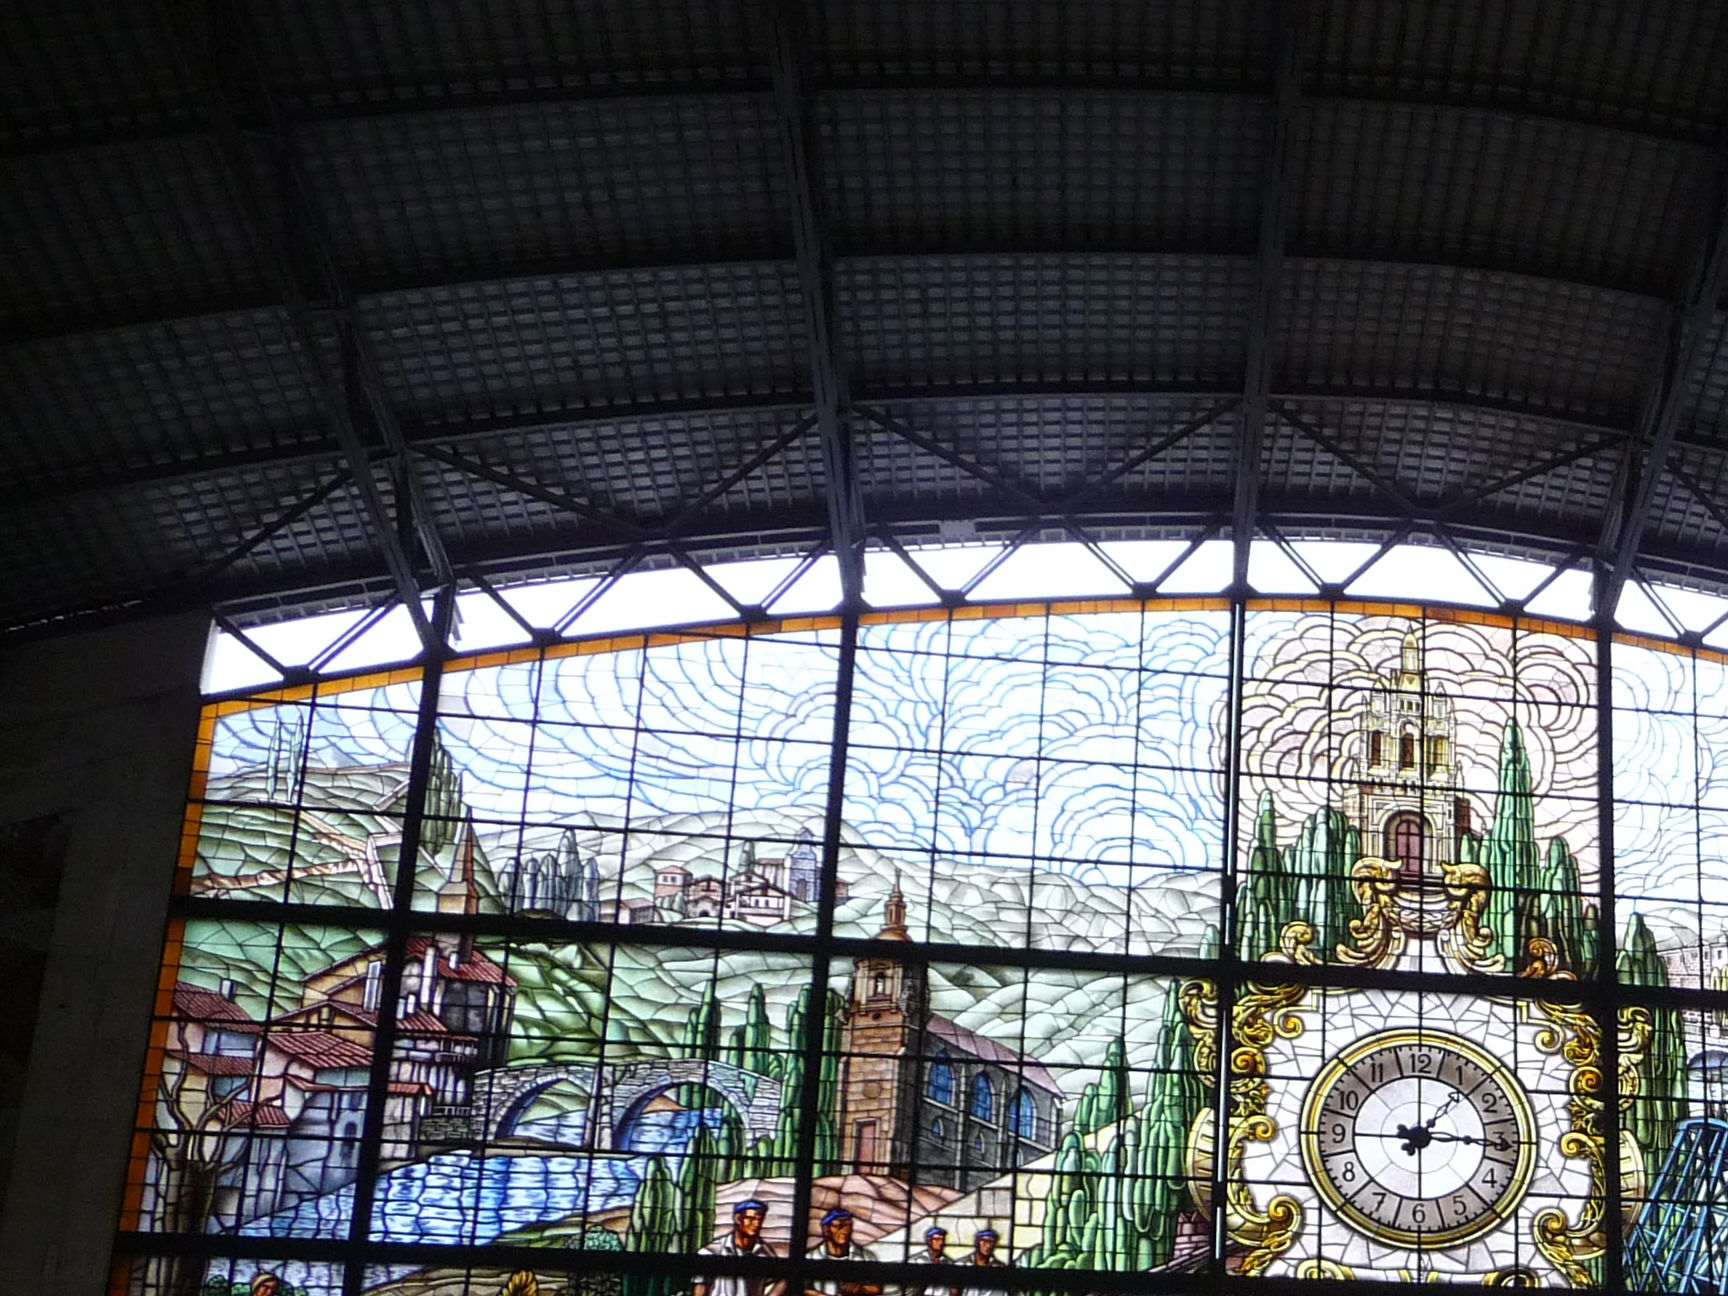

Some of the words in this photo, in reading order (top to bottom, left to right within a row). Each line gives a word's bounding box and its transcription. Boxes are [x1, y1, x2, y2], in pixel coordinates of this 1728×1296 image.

[1371, 1063, 1384, 1083] 11
[1411, 1053, 1432, 1073] 12
[1454, 1066, 1465, 1086] 1
[1339, 1090, 1358, 1110] 10
[1483, 1092, 1497, 1113] 2
[1332, 1124, 1345, 1143] 9
[1342, 1161, 1356, 1182] 8
[1481, 1168, 1497, 1188] 4
[1372, 1192, 1386, 1213] 7
[1453, 1194, 1467, 1216] 5
[1412, 1203, 1425, 1224] 6
